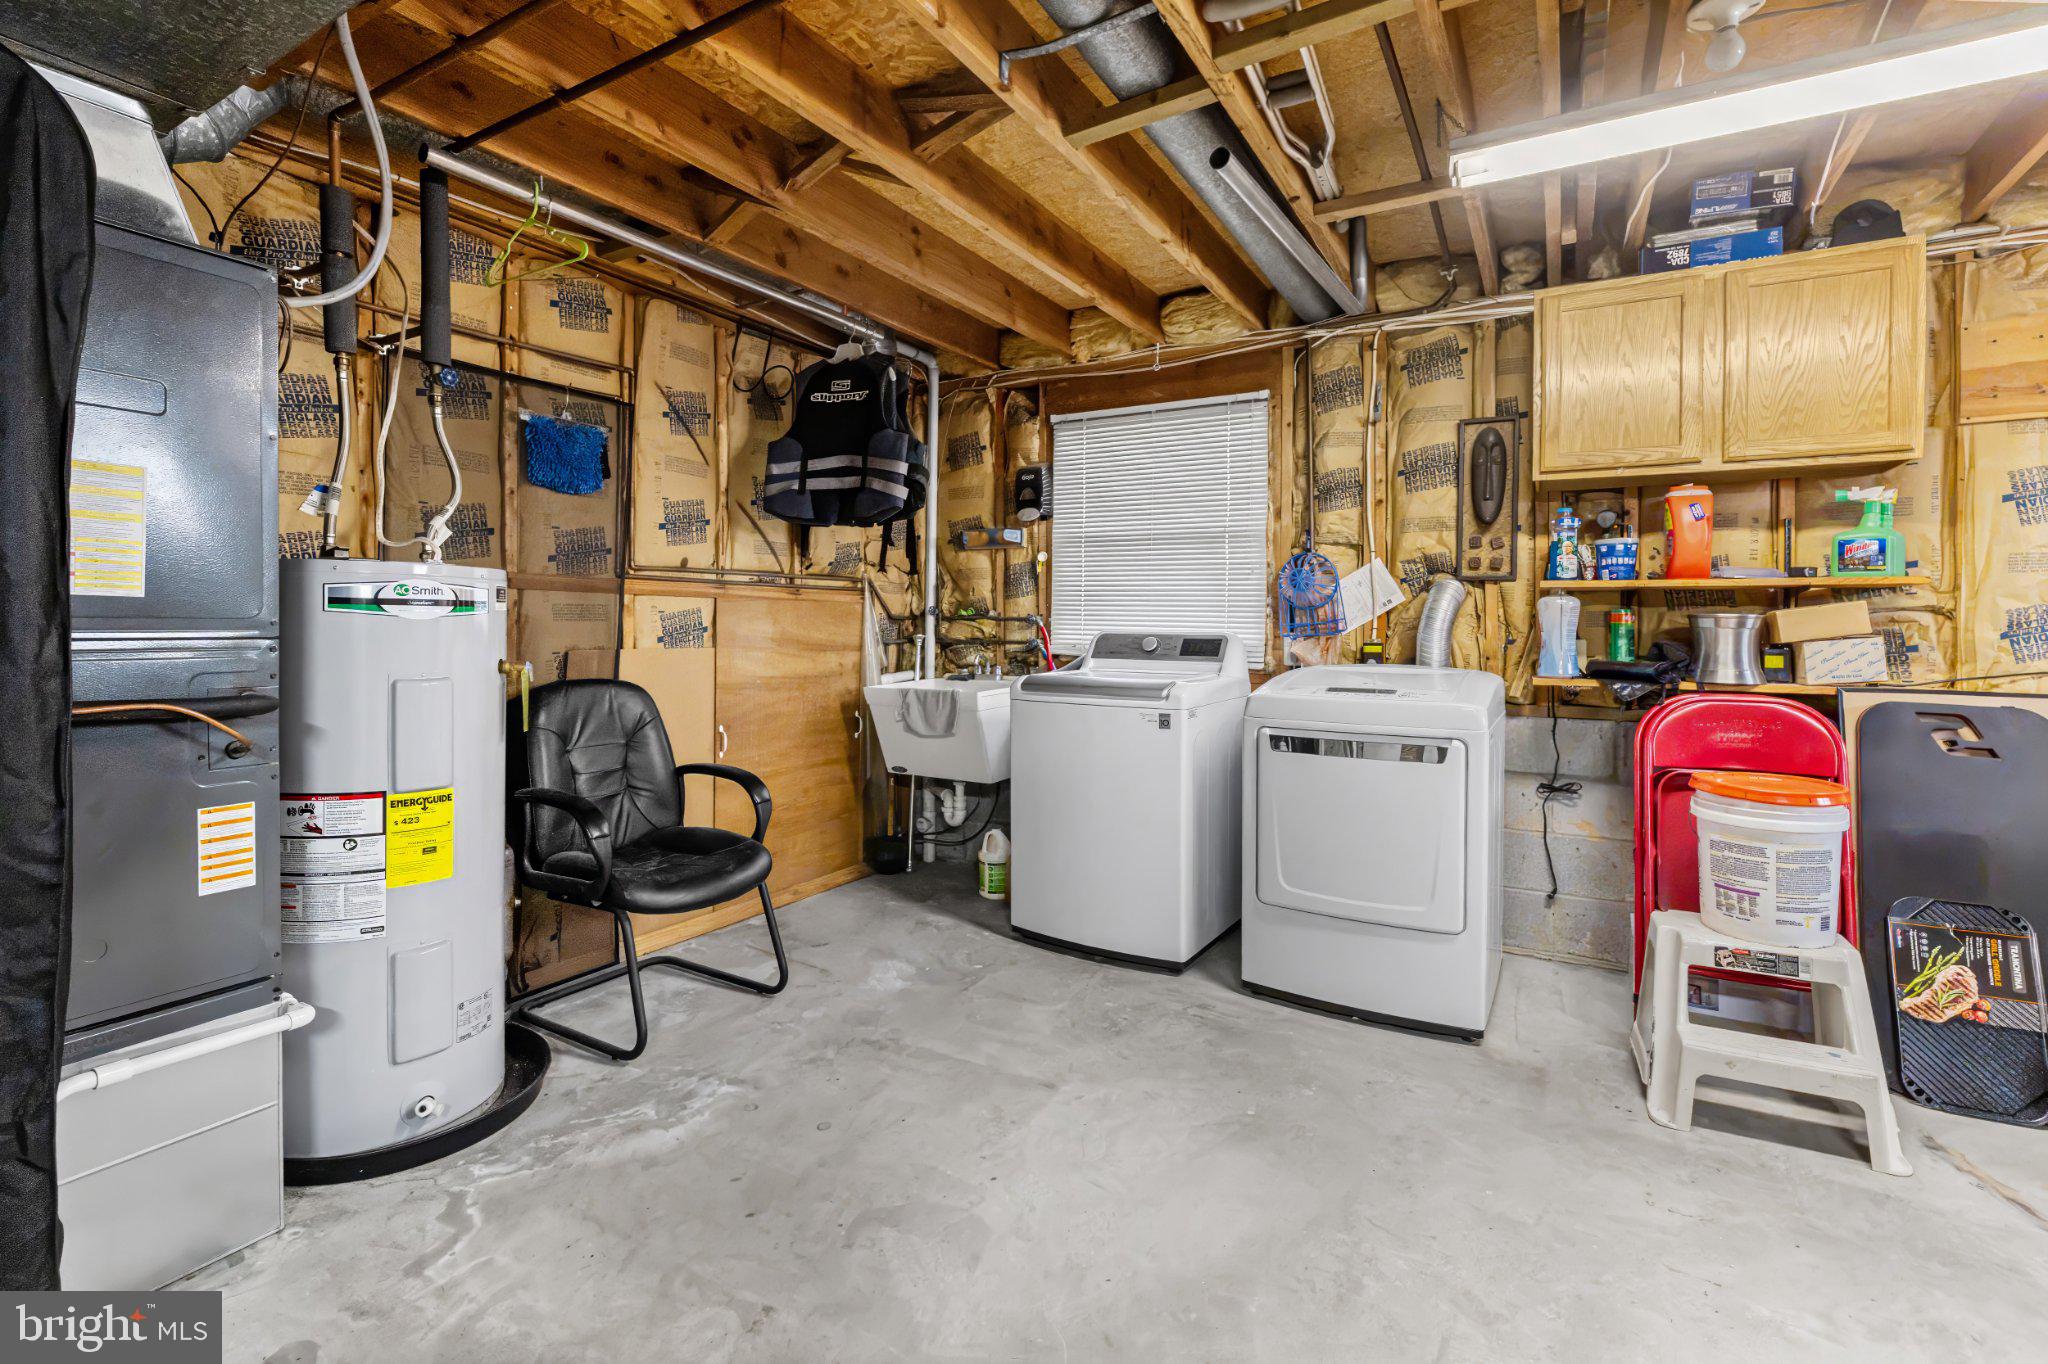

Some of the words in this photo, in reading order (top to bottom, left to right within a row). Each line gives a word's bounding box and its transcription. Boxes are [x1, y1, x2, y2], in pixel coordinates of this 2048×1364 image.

[664, 513, 706, 523] GUARDIAN
[662, 621, 703, 636] GUARDIAN
[401, 816, 420, 825] 423
[1991, 939, 1999, 958] GRILL
[1992, 959, 2003, 987] GRIDDLE
[2010, 945, 2023, 990] TRAMONTINA
